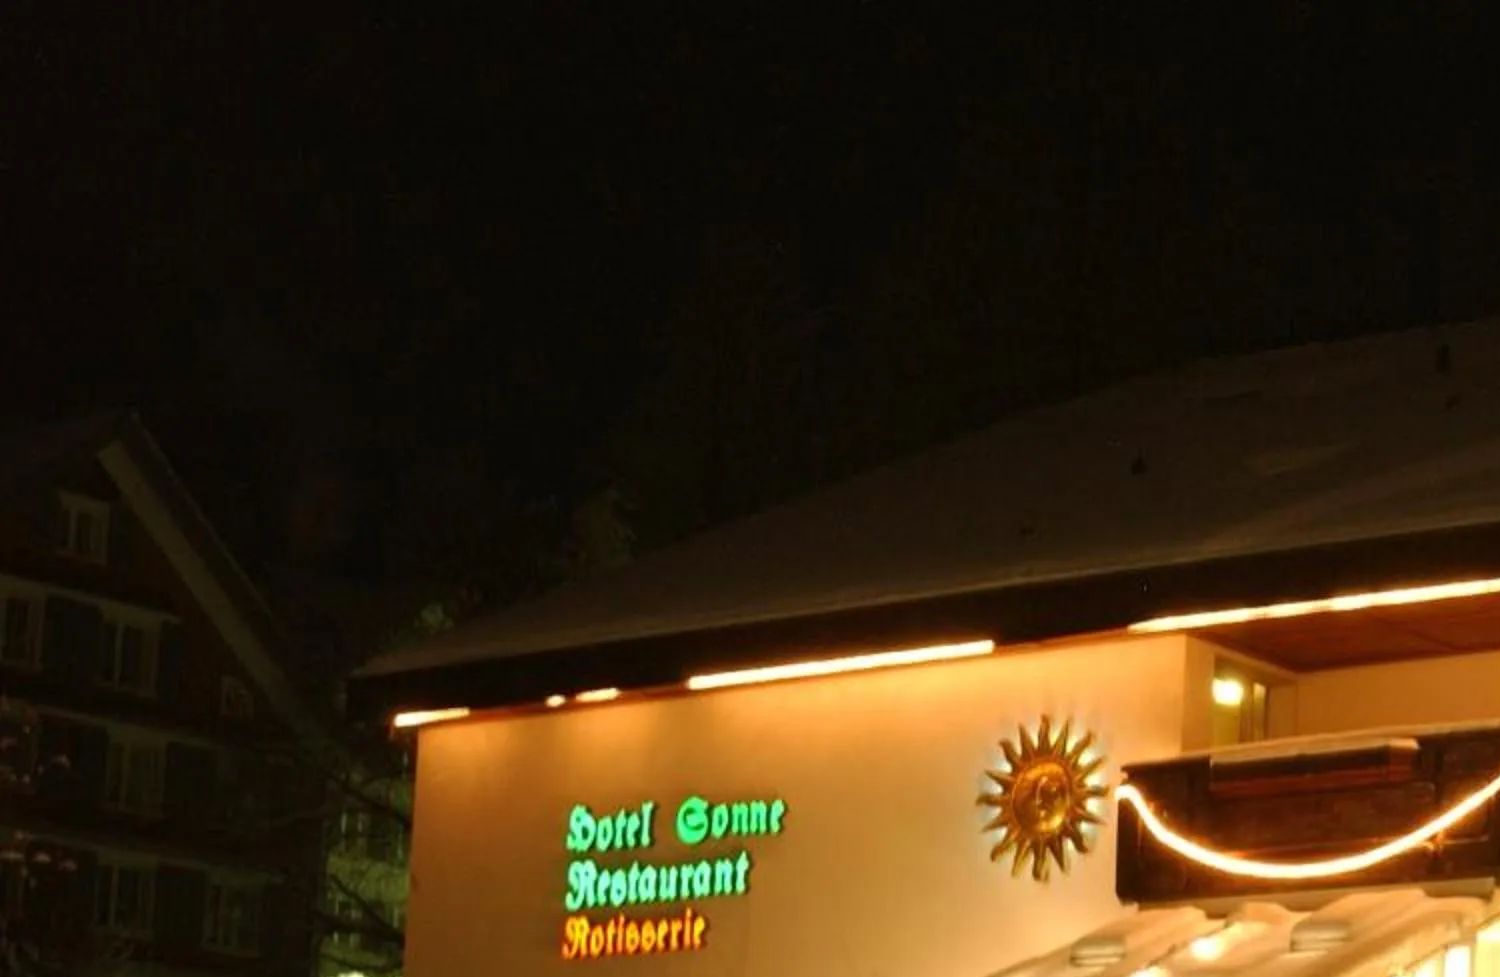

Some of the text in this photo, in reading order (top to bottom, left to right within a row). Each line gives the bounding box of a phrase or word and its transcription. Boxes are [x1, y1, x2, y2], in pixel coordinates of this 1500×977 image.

[566, 796, 785, 852] Hotel Sonne
[565, 851, 750, 911] Restaurant
[562, 907, 706, 959] Rotisserie
